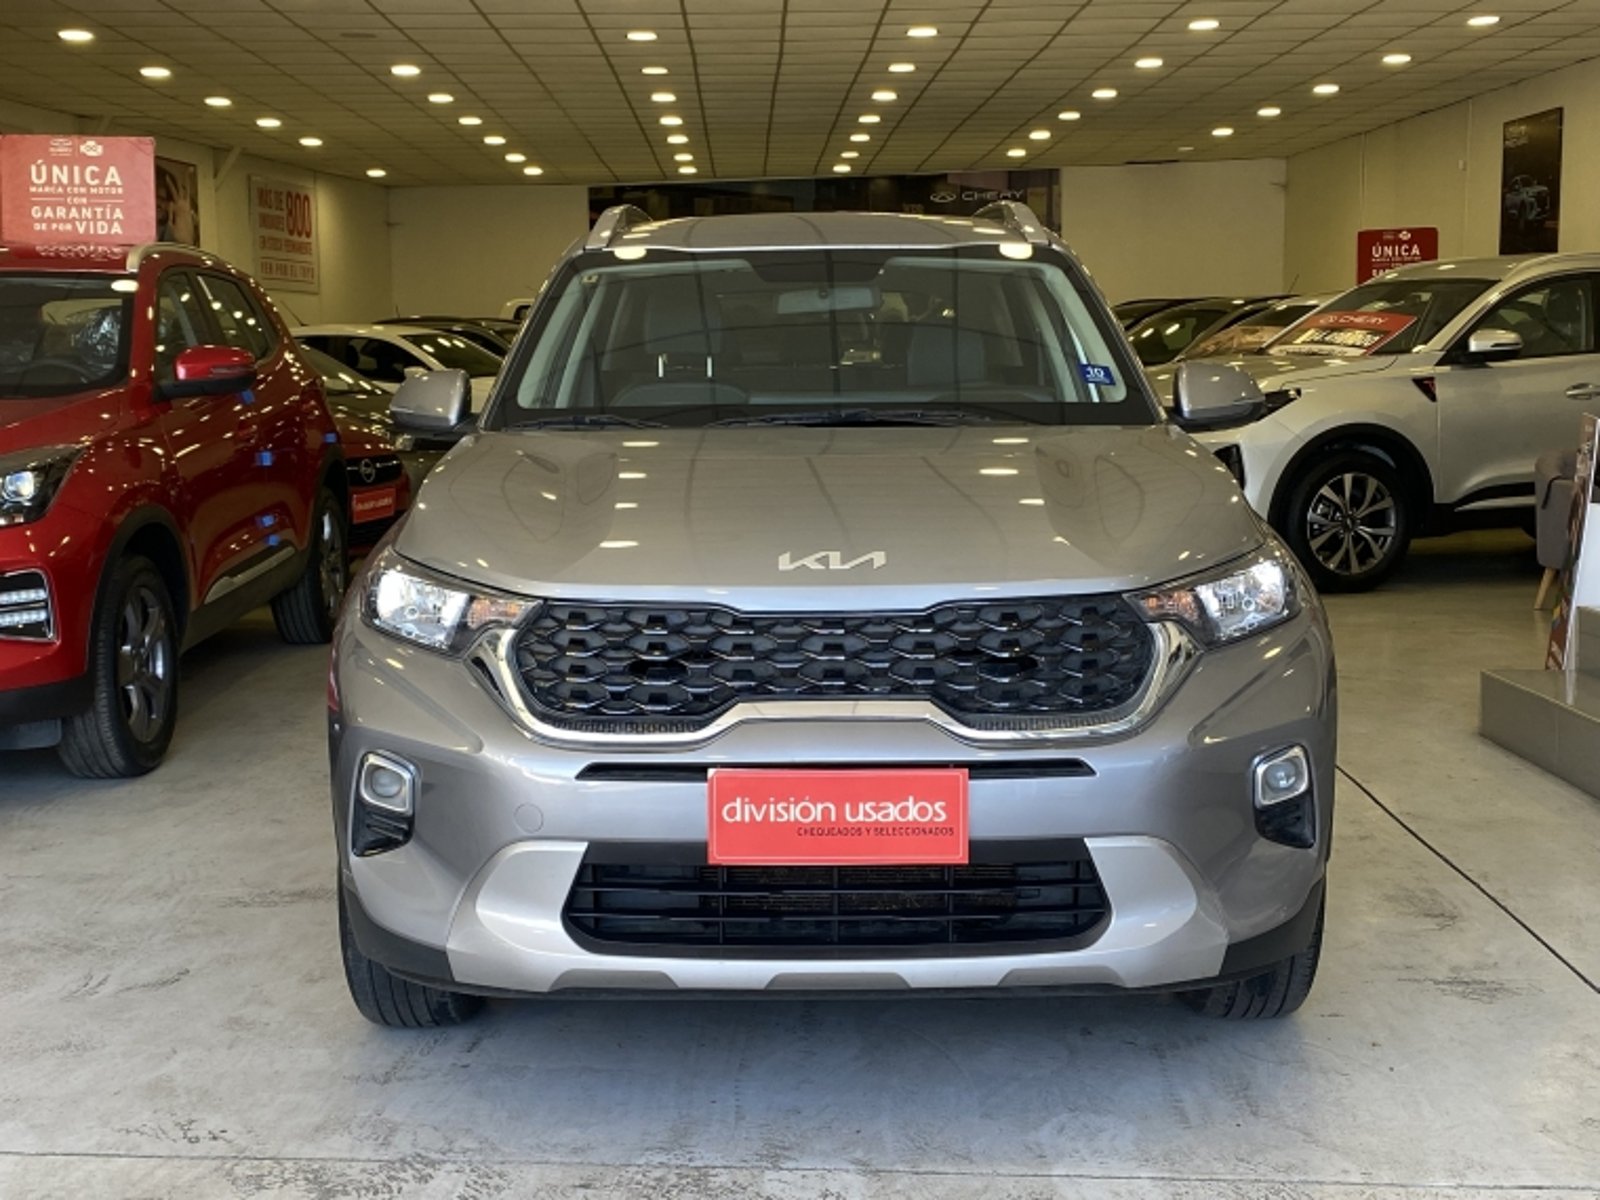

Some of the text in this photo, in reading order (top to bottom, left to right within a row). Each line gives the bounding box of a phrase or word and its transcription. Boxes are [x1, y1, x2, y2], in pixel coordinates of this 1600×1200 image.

[31, 160, 122, 185] ÚNICA
[66, 196, 87, 204] CON
[962, 189, 1023, 200] CHERY
[31, 204, 123, 219] GARANTÍA
[33, 221, 122, 234] DE POR VIDA
[1372, 243, 1420, 257] ÚNICA
[721, 795, 947, 823] división usados
[797, 827, 954, 836] CHEQUEADOS Y SELECCIONADOS
